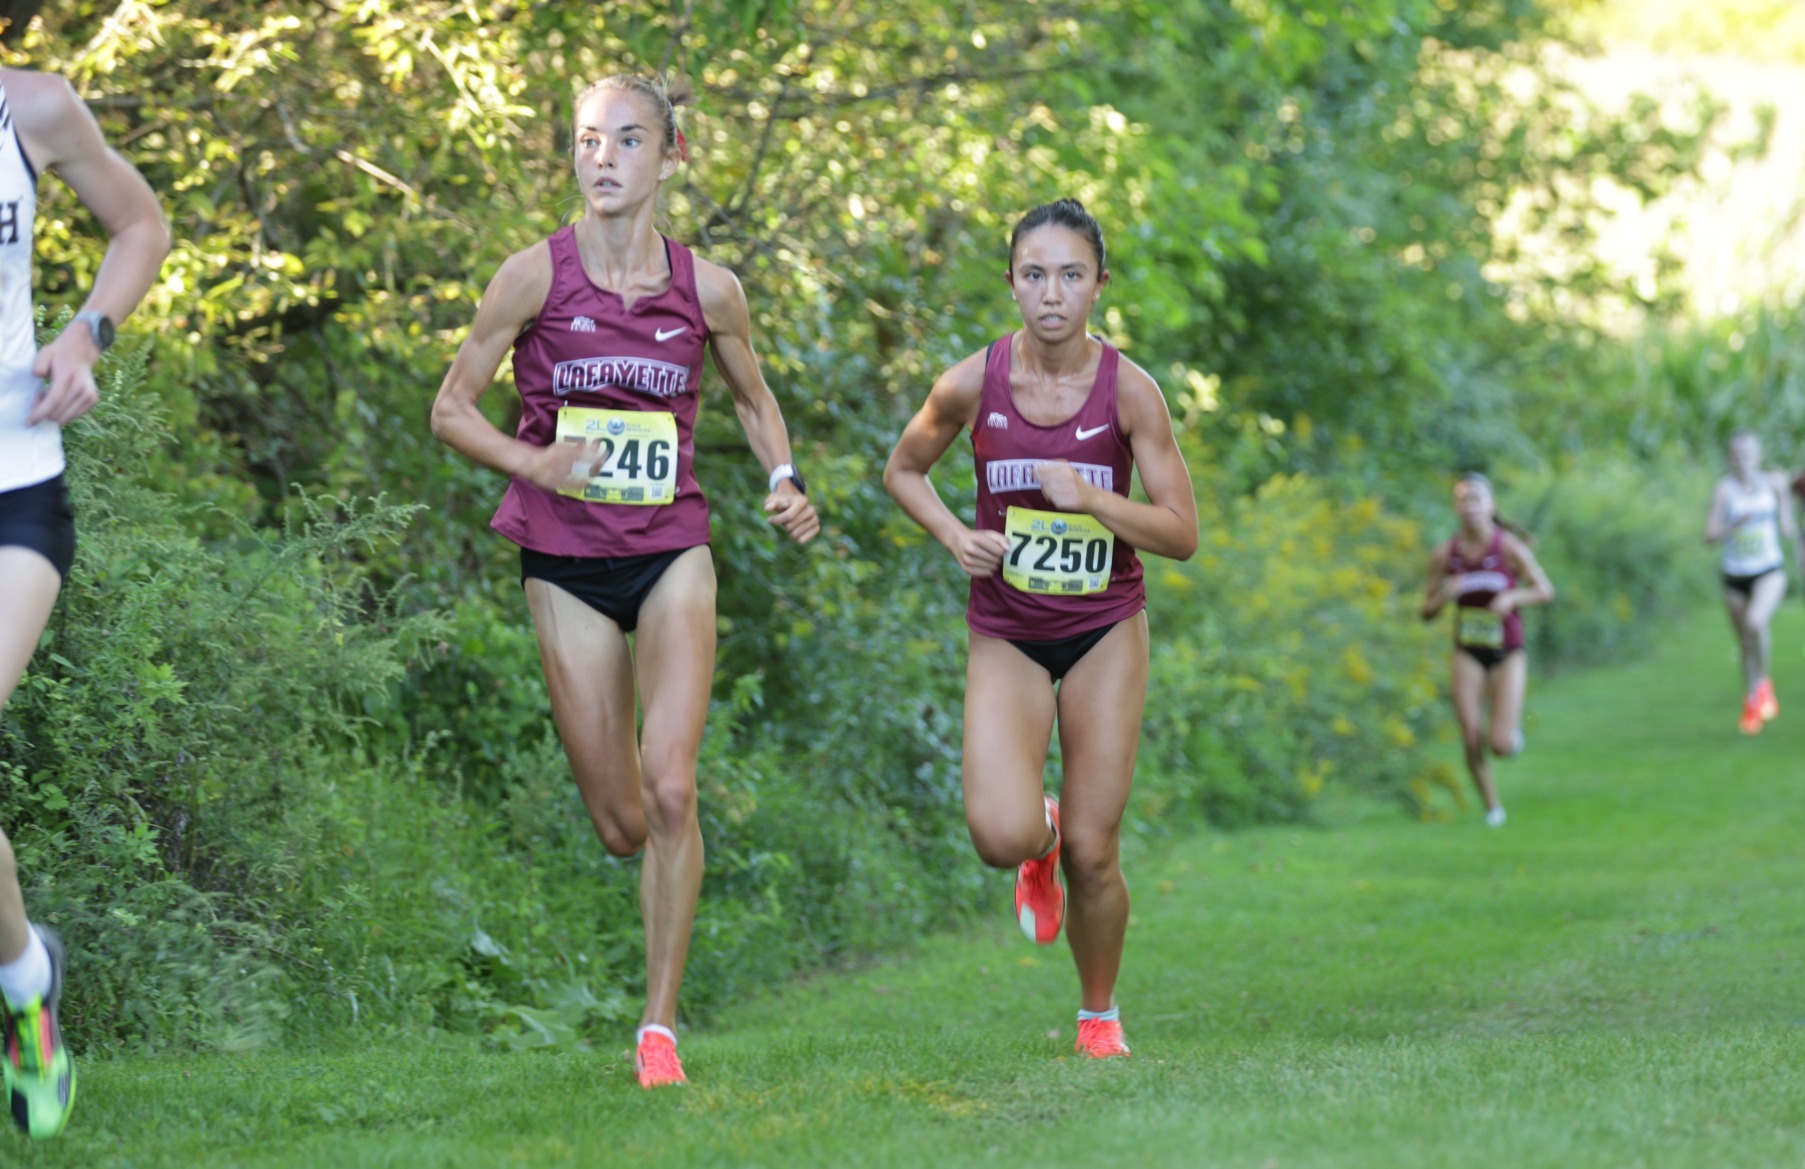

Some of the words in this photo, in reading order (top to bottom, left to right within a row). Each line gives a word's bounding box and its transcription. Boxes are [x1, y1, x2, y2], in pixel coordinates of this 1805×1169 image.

[0, 202, 19, 244] H
[555, 357, 688, 396] LAFAYETTE
[988, 459, 1112, 493] LAFATE
[1009, 531, 1107, 574] 7250
